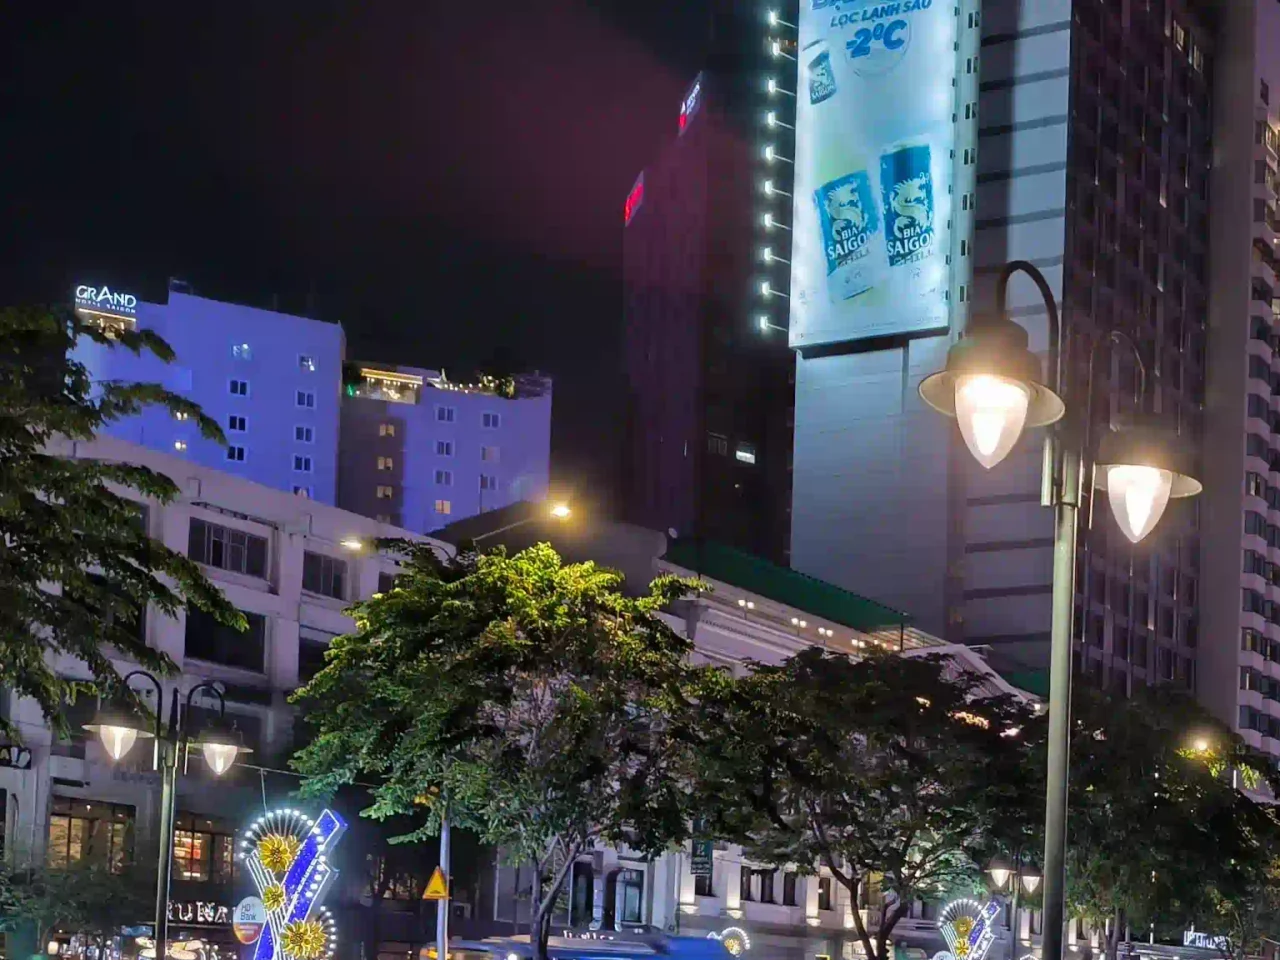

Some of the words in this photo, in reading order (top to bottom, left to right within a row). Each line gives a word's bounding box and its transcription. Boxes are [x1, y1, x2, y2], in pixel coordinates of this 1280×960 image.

[862, 3, 900, 22] LẠNH
[841, 227, 858, 240] BIA
[903, 227, 921, 238] BIA
[887, 231, 935, 256] SAIGON
[76, 285, 136, 308] GRAND
[241, 912, 257, 920] Bank
